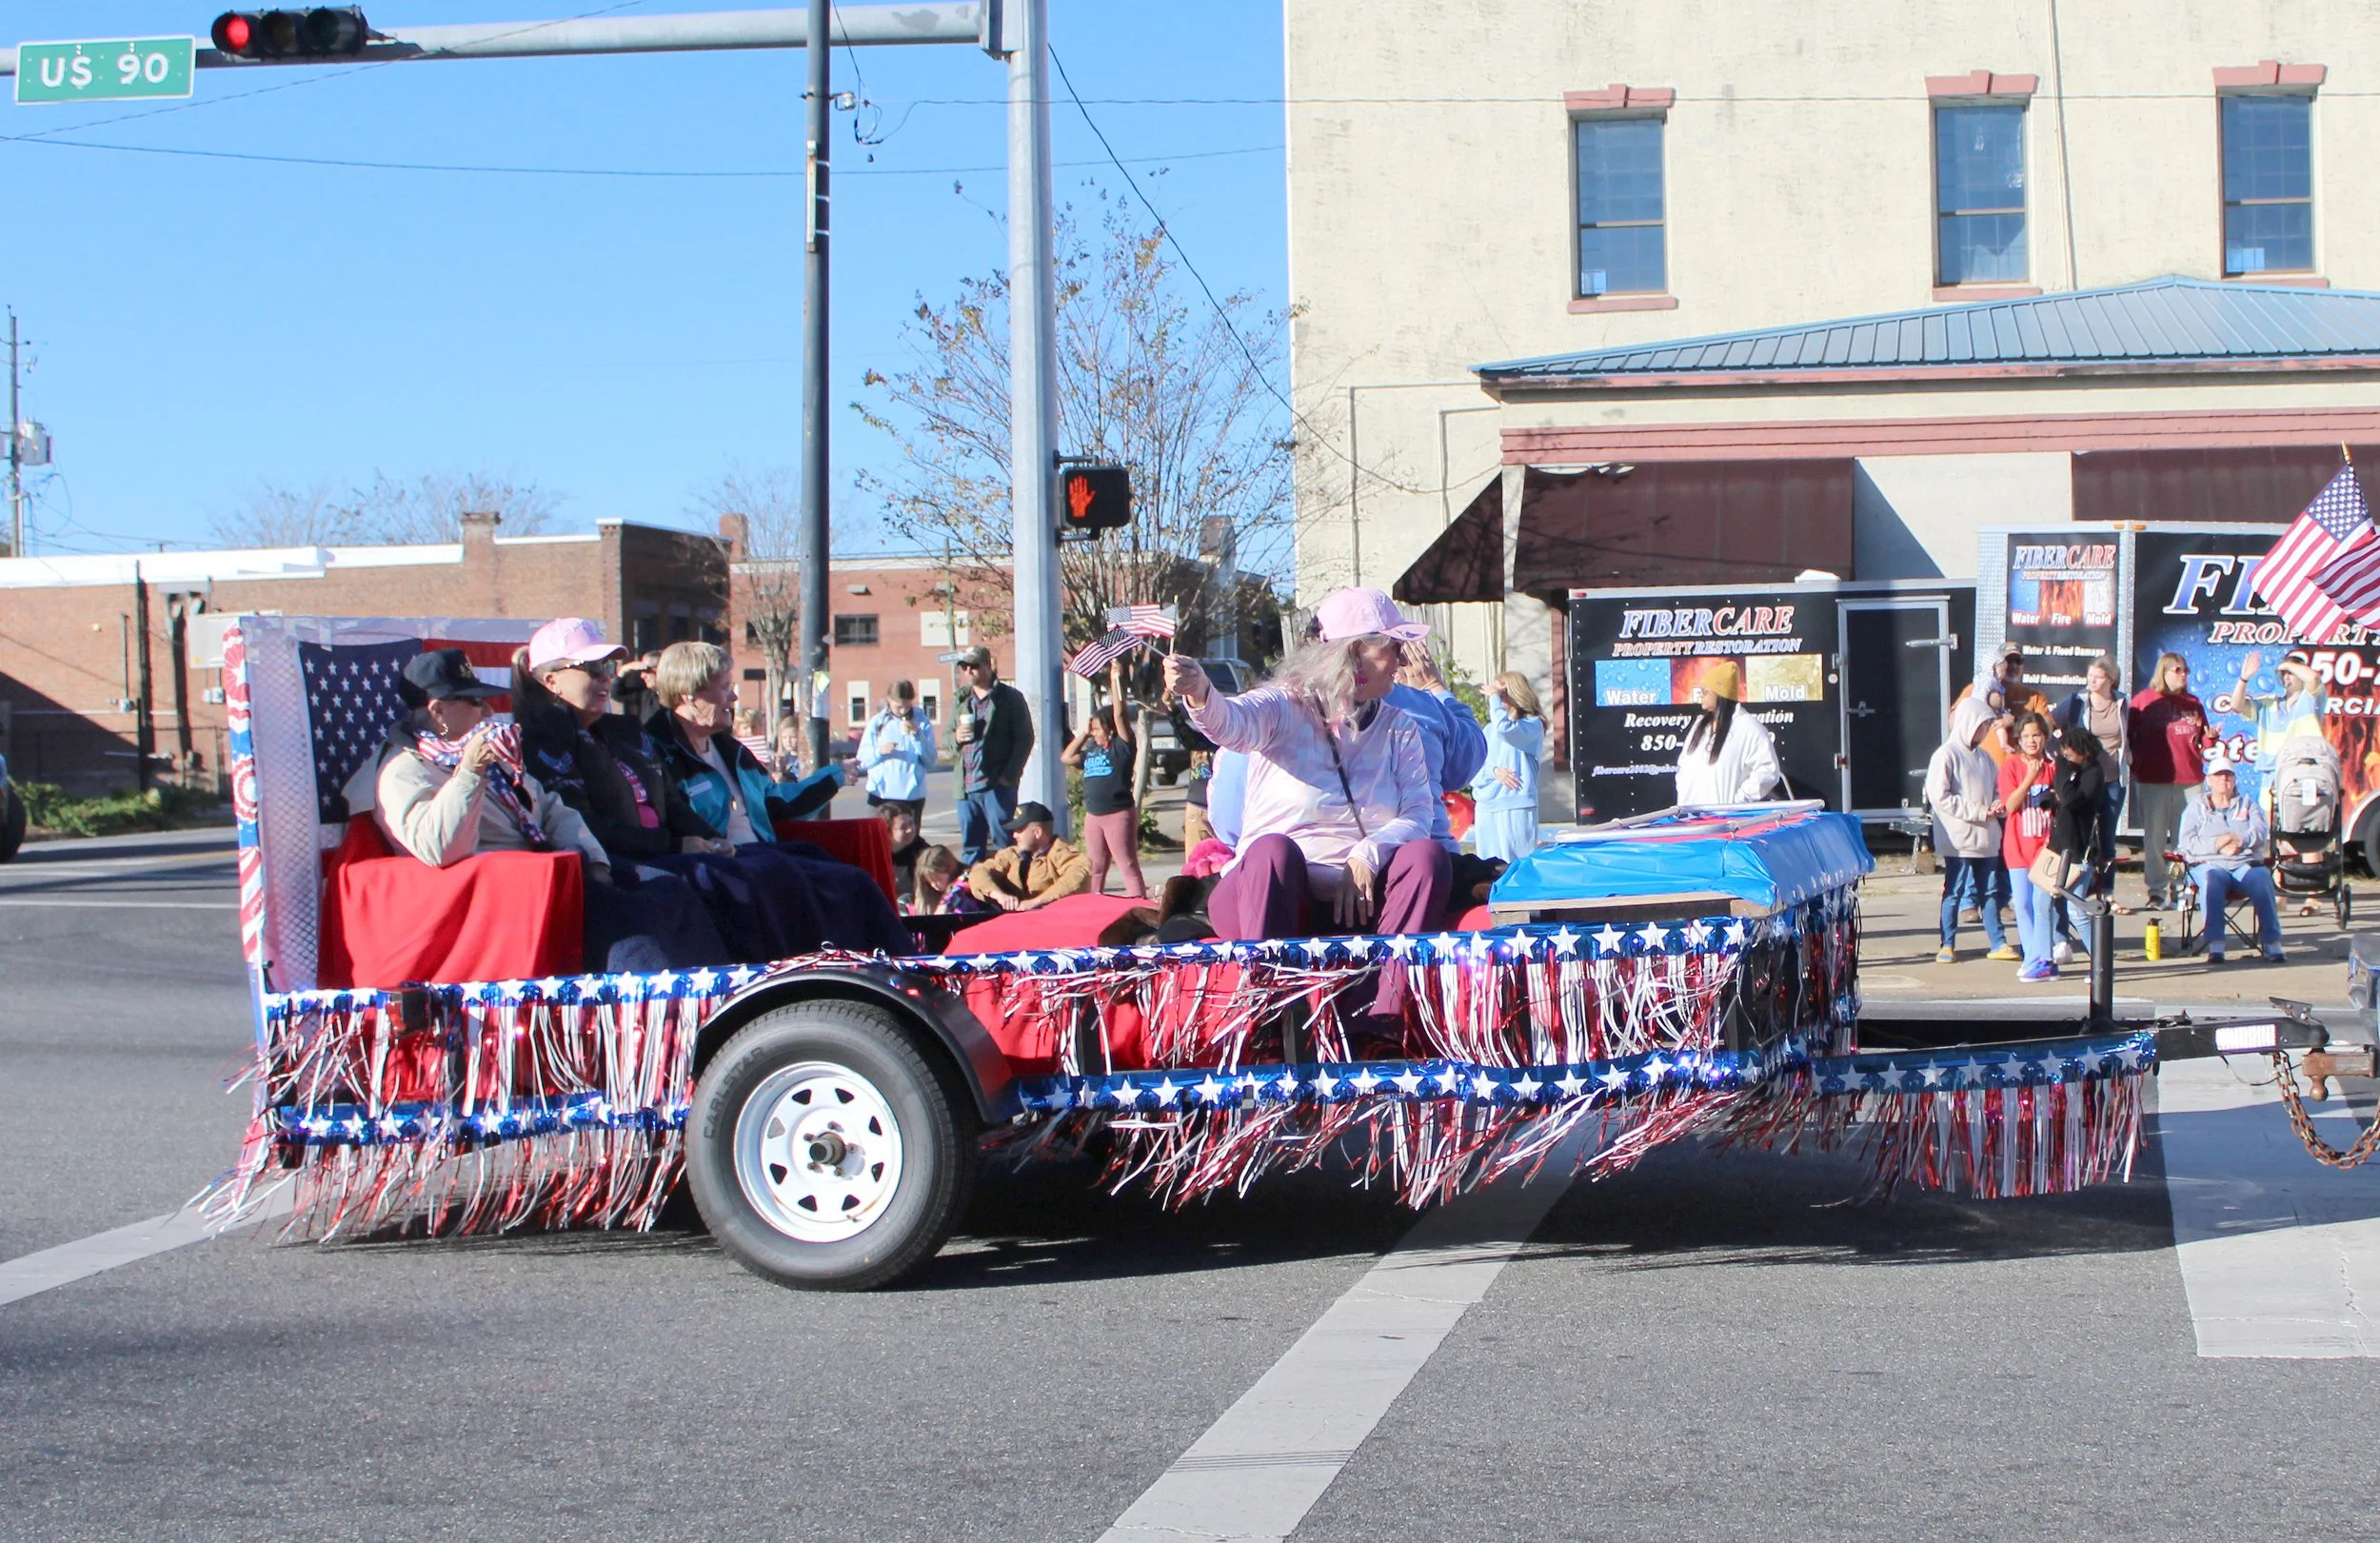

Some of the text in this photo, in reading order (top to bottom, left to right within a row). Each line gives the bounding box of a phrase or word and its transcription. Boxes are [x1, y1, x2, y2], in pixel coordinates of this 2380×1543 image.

[41, 52, 169, 89] US 90
[2013, 544, 2117, 569] FIBERCARE
[1618, 605, 1795, 639] FIBERCARE
[2012, 612, 2112, 625] Water Fire Mold
[1612, 639, 1802, 657] PROPERTY RESTORATION
[2022, 645, 2106, 658] Water & Flood Damage
[2022, 674, 2087, 685] Mold Remediation
[1605, 689, 1657, 705] Water
[1764, 685, 1807, 702] Mold
[1624, 713, 1692, 729] Recovery
